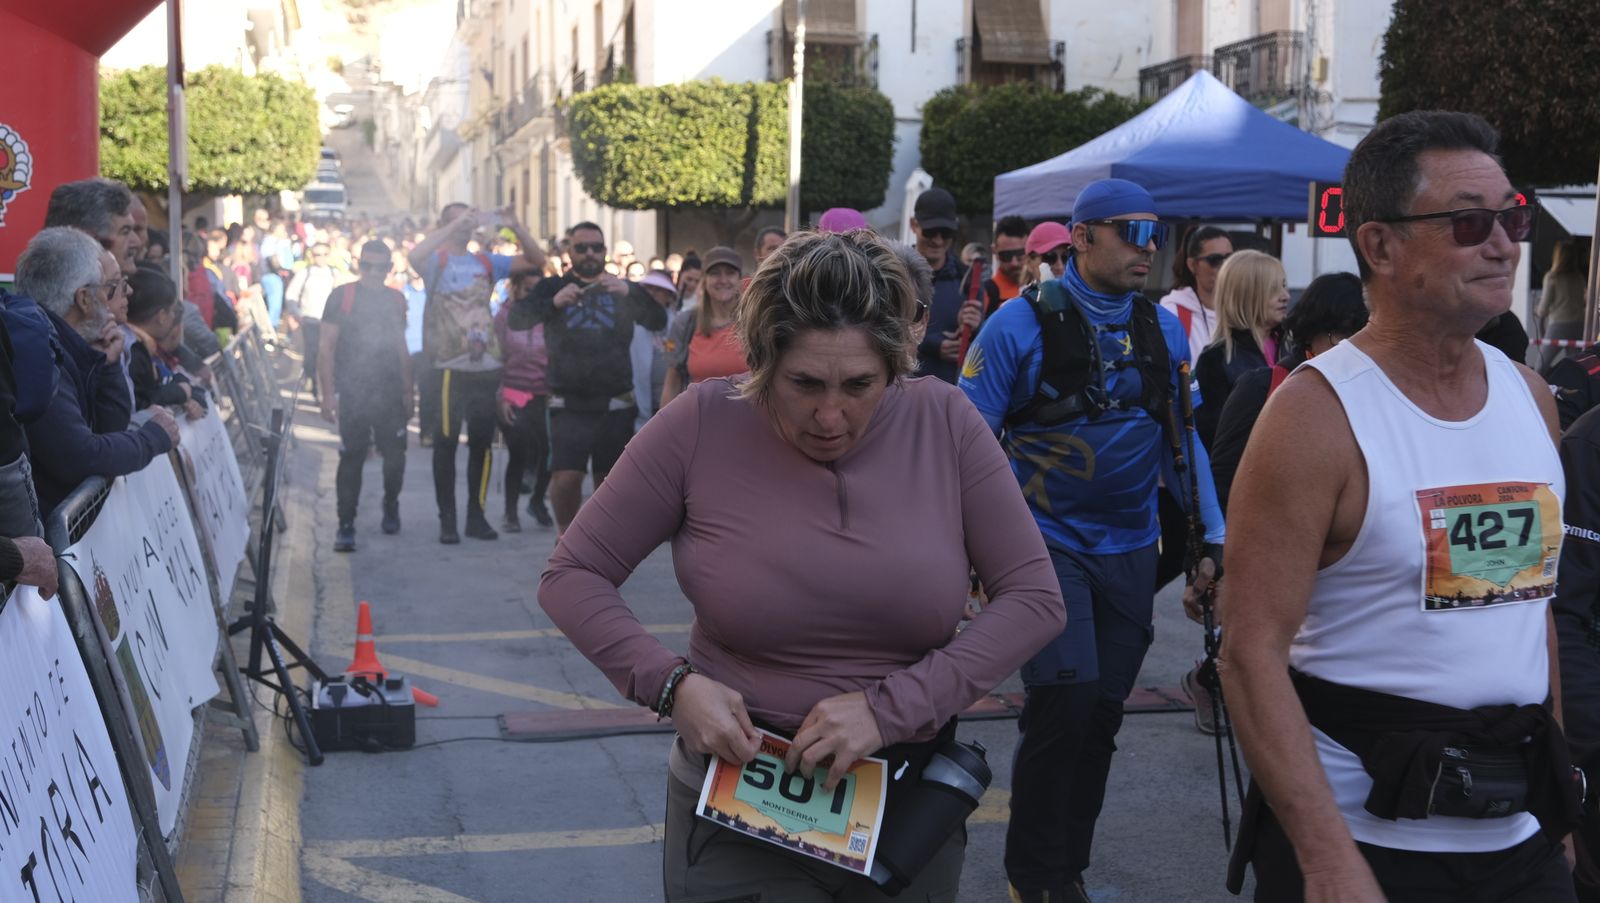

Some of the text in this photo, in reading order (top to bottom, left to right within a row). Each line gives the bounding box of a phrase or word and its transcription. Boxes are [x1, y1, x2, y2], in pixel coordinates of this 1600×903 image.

[1450, 507, 1536, 552] 427
[1486, 559, 1505, 568] JOHN
[742, 757, 848, 815] 501
[762, 799, 818, 824] MONTSERRAT
